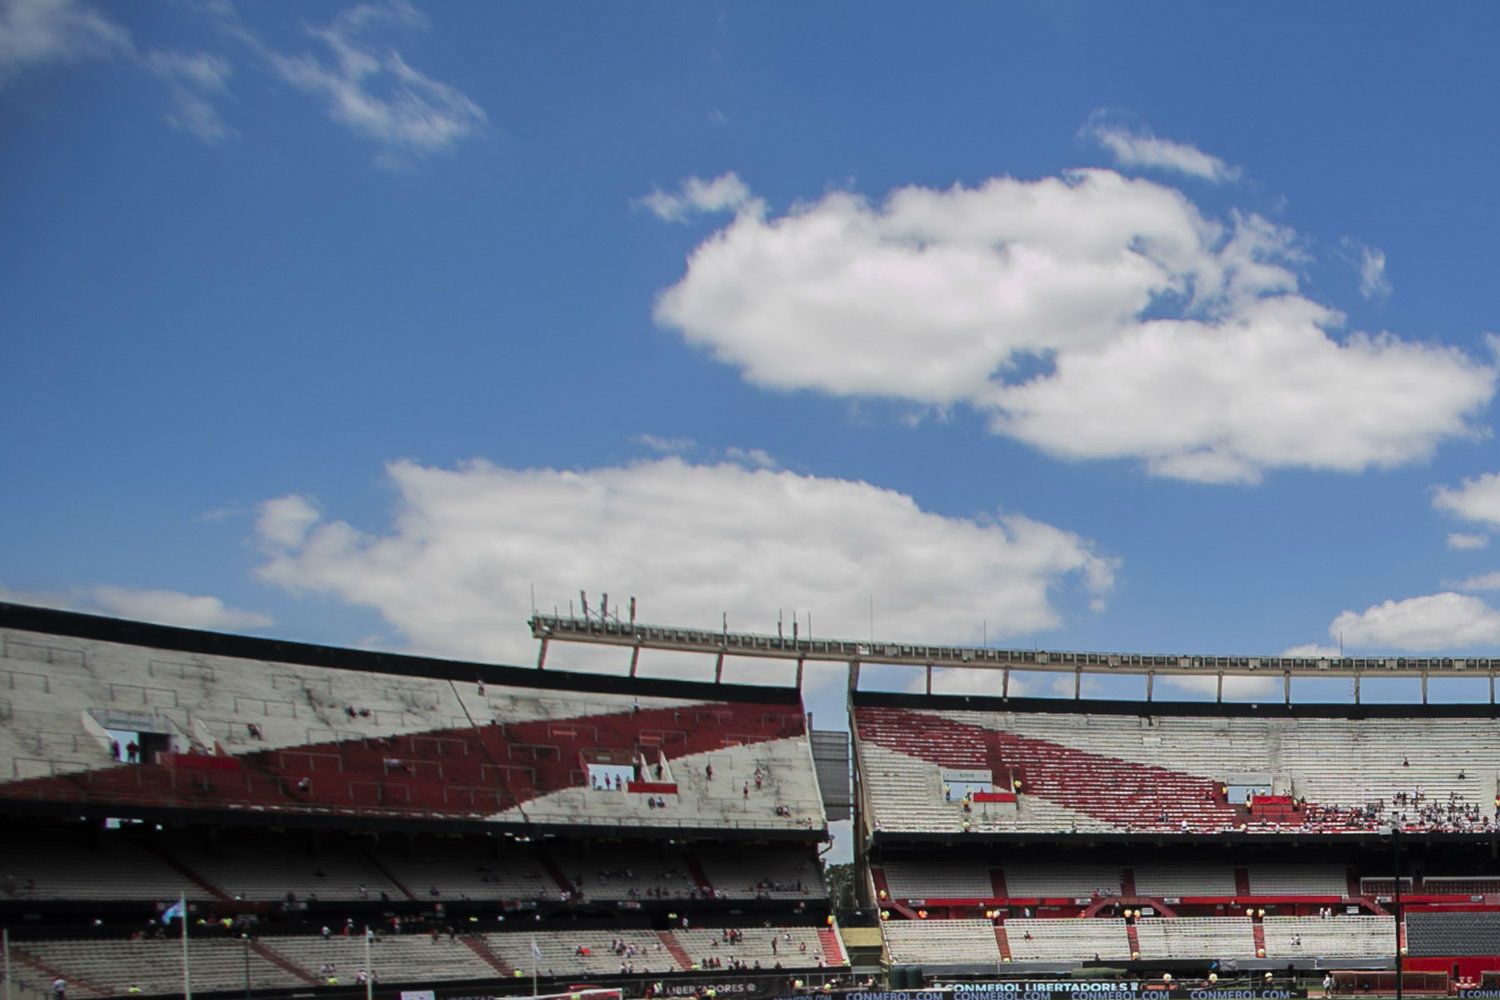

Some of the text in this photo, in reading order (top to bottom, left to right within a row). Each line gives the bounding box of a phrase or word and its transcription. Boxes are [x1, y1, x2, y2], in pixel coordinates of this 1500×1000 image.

[1025, 982, 1128, 992] LIBERTADORES
[1071, 991, 1170, 1000] CONMEBOL.COM
[1190, 990, 1290, 1000] CONMEBOL.COM
